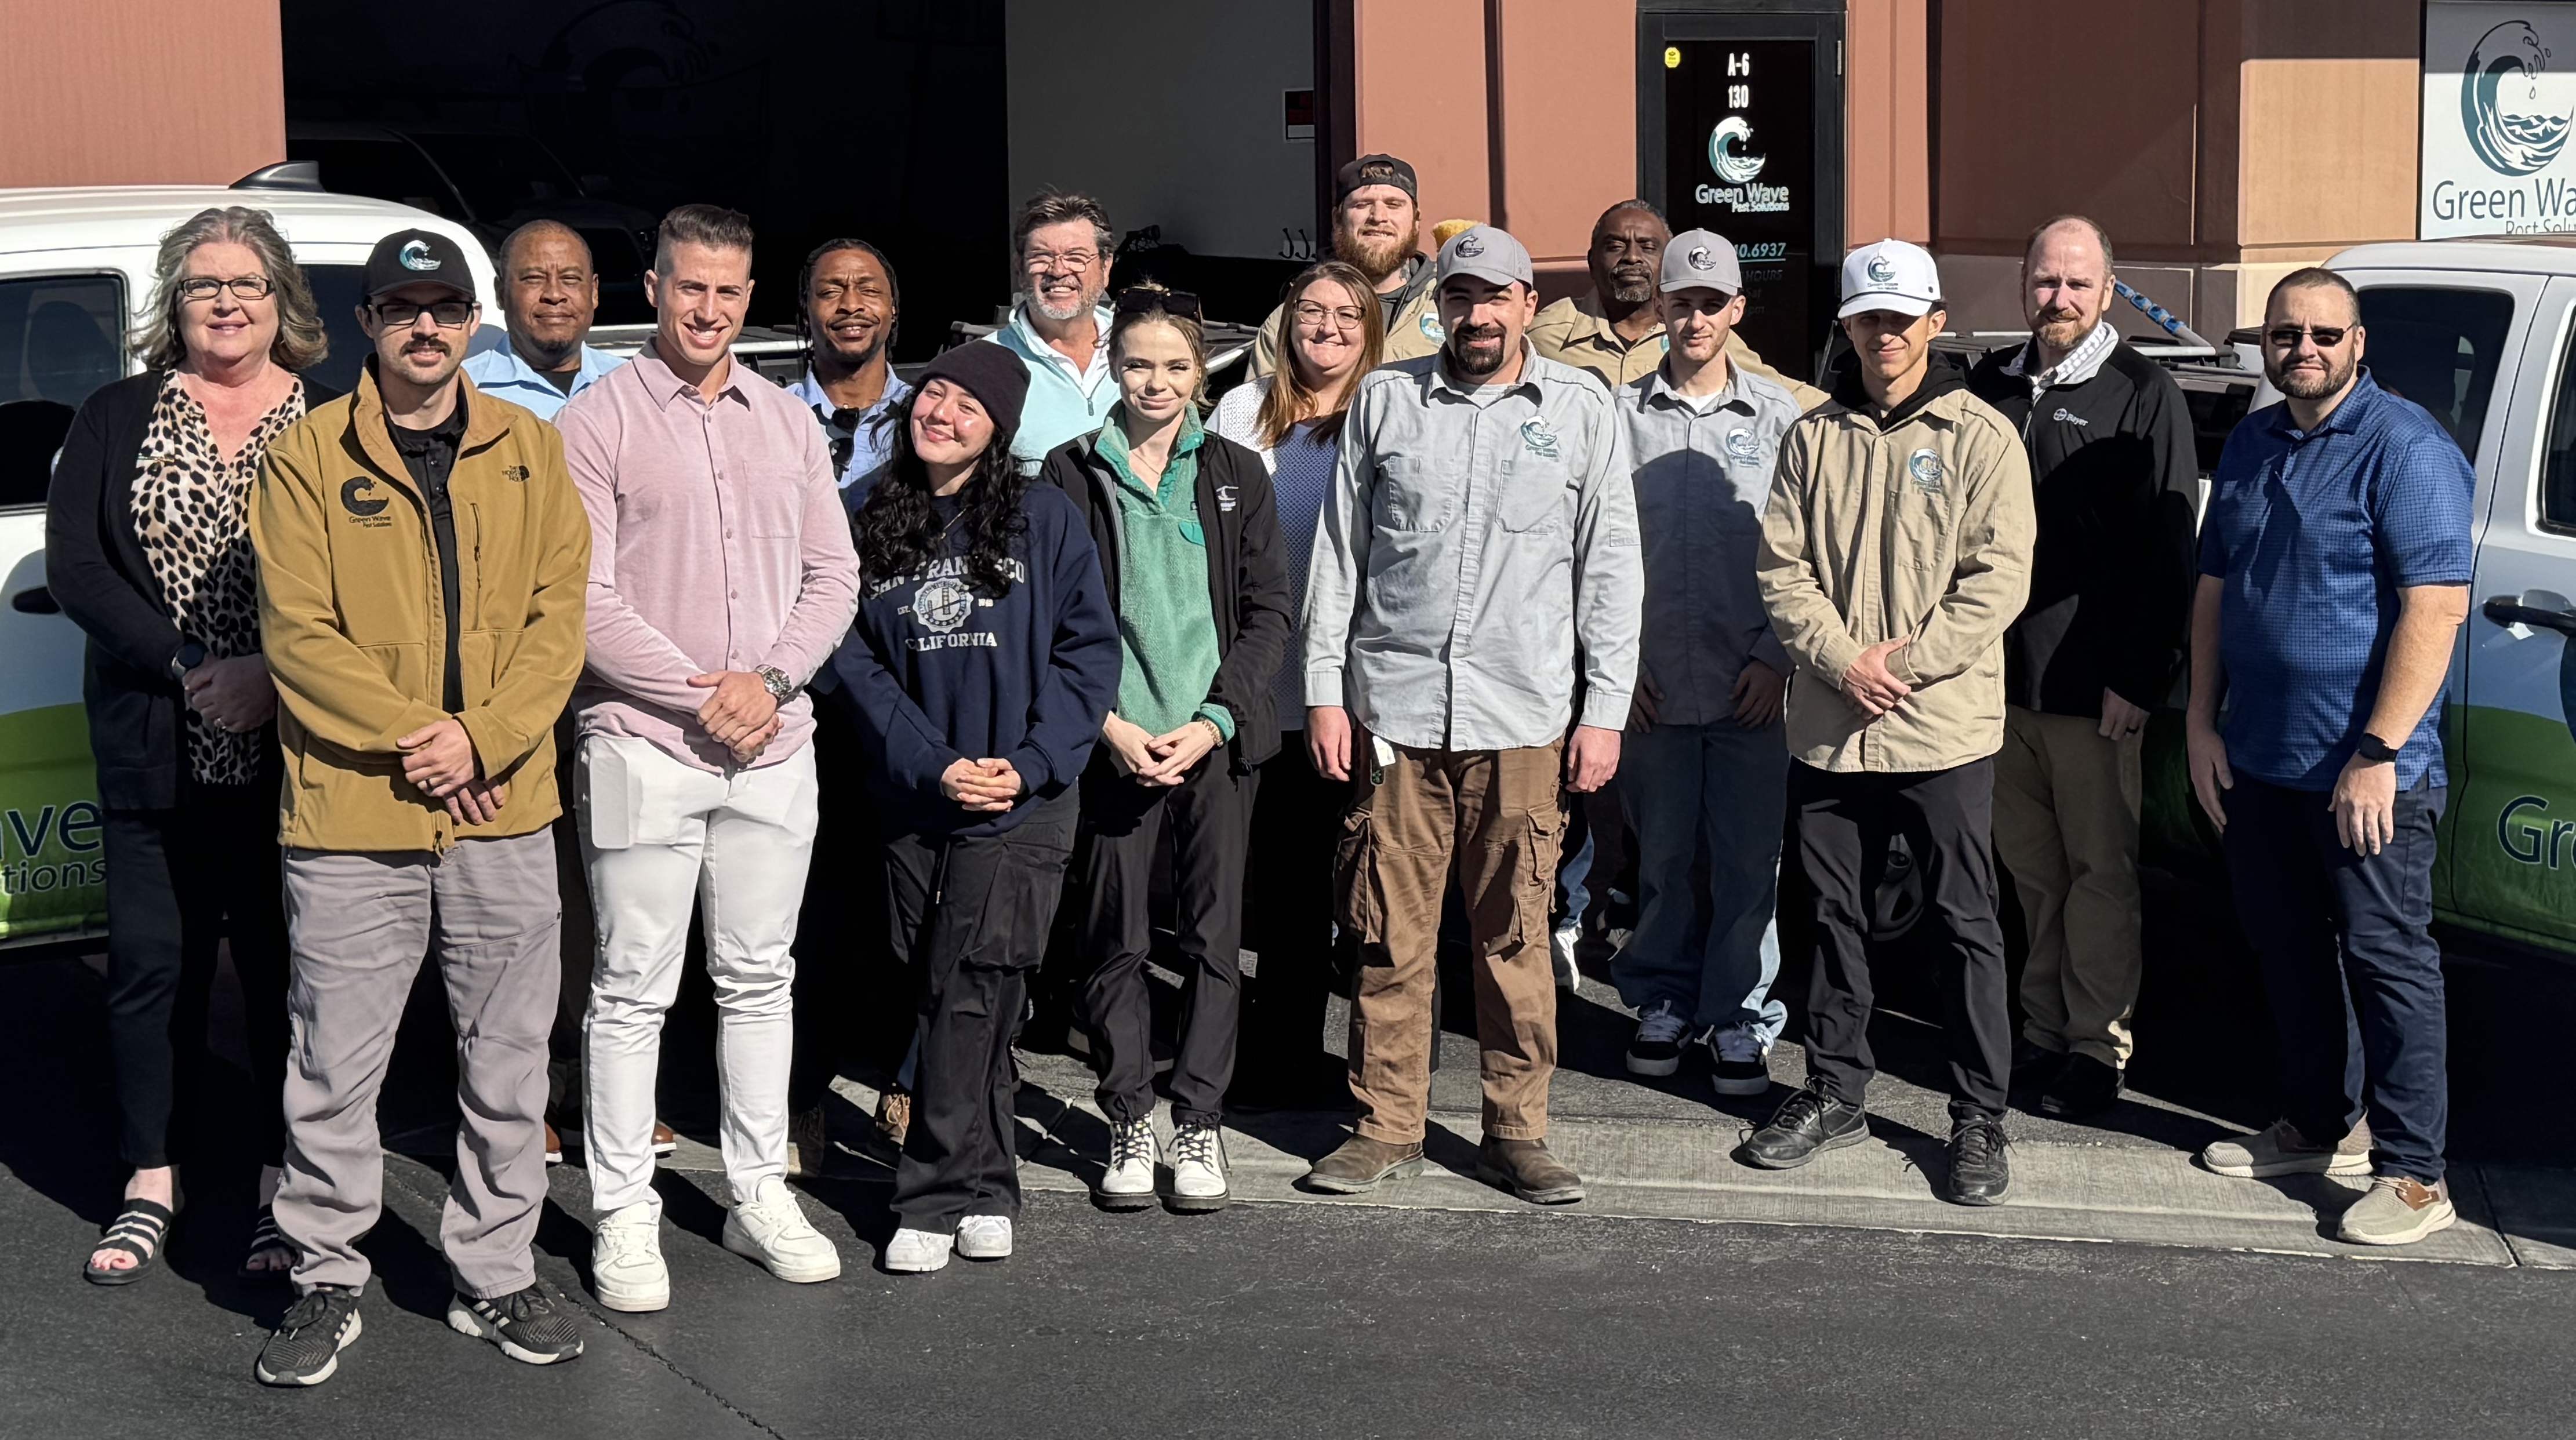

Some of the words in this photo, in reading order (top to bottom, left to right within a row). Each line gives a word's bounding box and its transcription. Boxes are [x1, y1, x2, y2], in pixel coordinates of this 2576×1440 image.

[1728, 53, 1750, 76] A-6
[1728, 85, 1749, 108] 130
[1695, 184, 1743, 203] Green
[1746, 183, 1789, 202] Wave
[2433, 180, 2525, 220] Green
[905, 632, 997, 652] CLIFORNIA
[0, 800, 103, 861] ve
[2497, 795, 2576, 870] Gr
